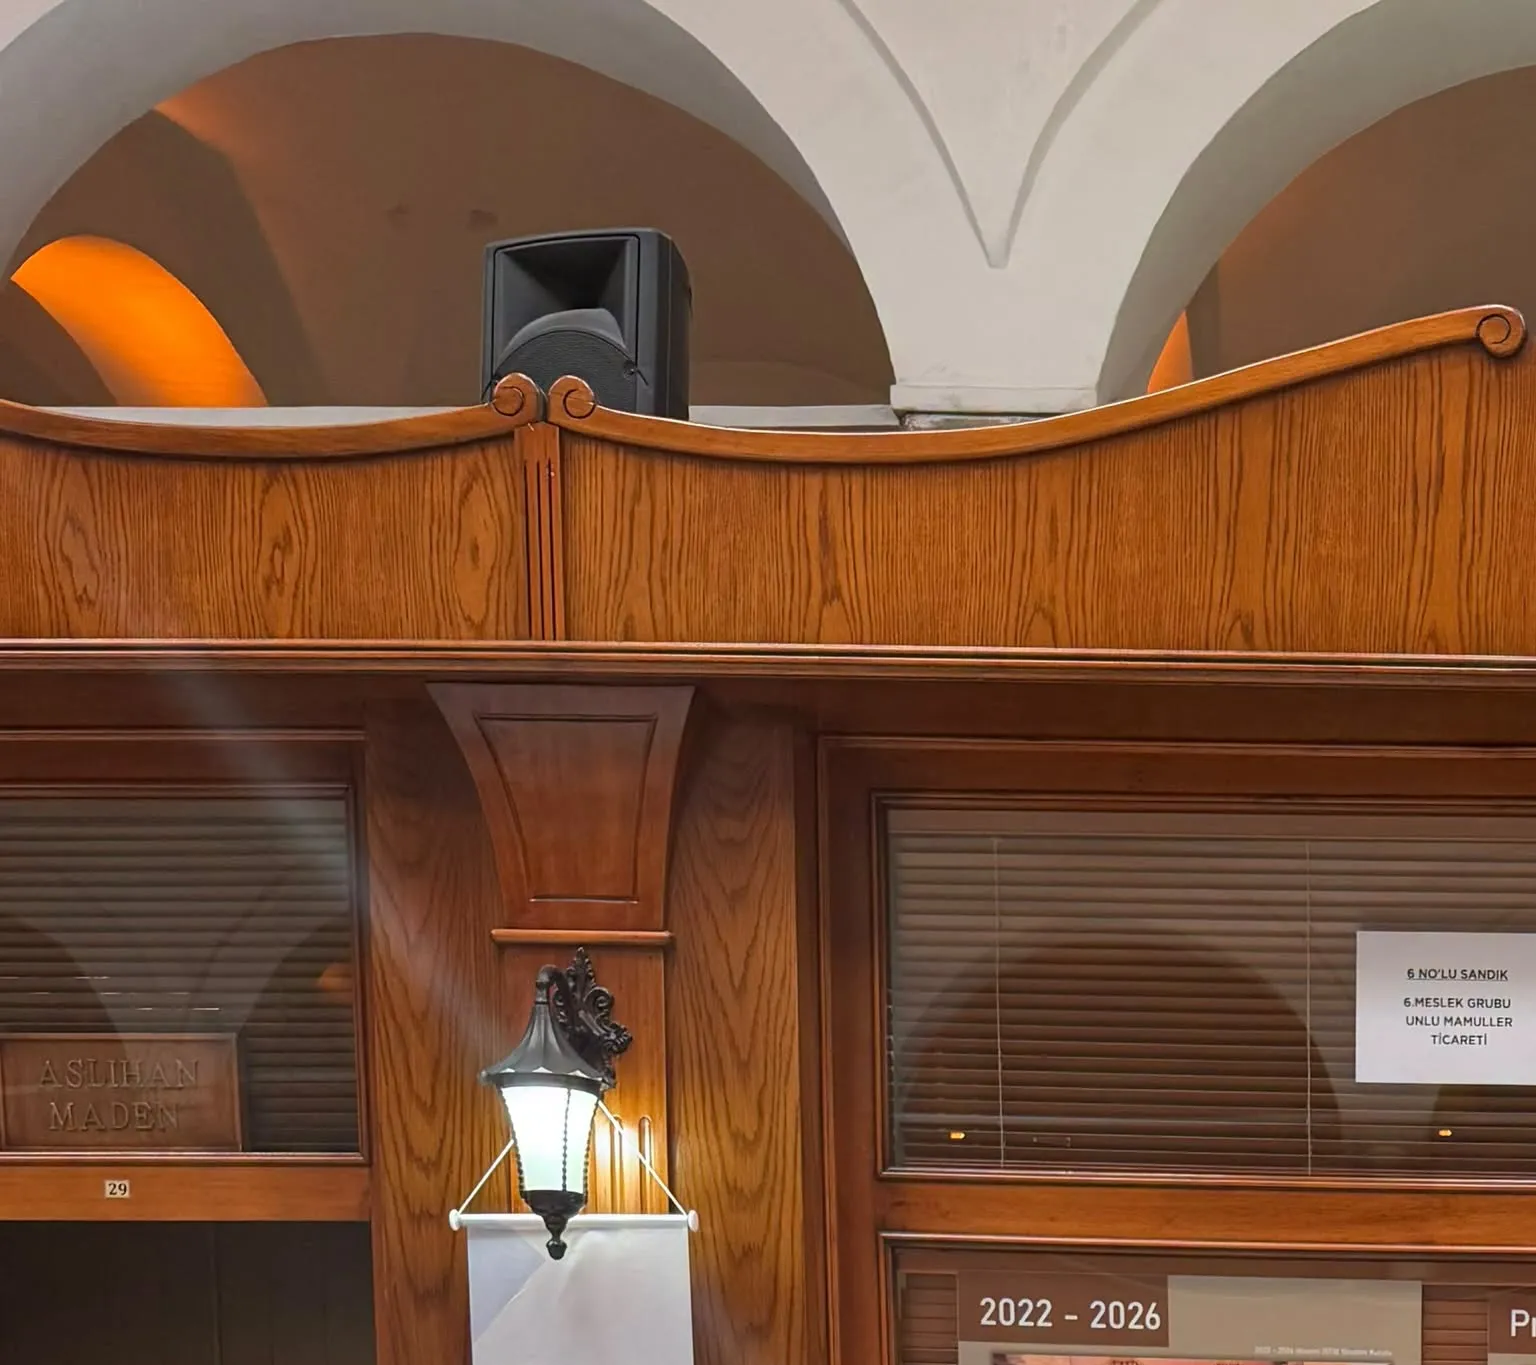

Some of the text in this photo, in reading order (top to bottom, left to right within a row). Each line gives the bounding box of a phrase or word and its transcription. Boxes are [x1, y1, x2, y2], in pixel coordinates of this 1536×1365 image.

[1407, 968, 1415, 980] 6
[1460, 969, 1509, 981] SANDIK
[1467, 998, 1512, 1009] GRUBU
[1406, 1015, 1513, 1028] UNLU MAMULLER
[1431, 1032, 1488, 1046] TİCARETİ
[40, 1058, 200, 1091] ASLIHAN
[49, 1102, 180, 1132] MADEN
[108, 1182, 127, 1197] 29
[979, 1297, 1053, 1327] 2022
[1089, 1299, 1161, 1331] 2026
